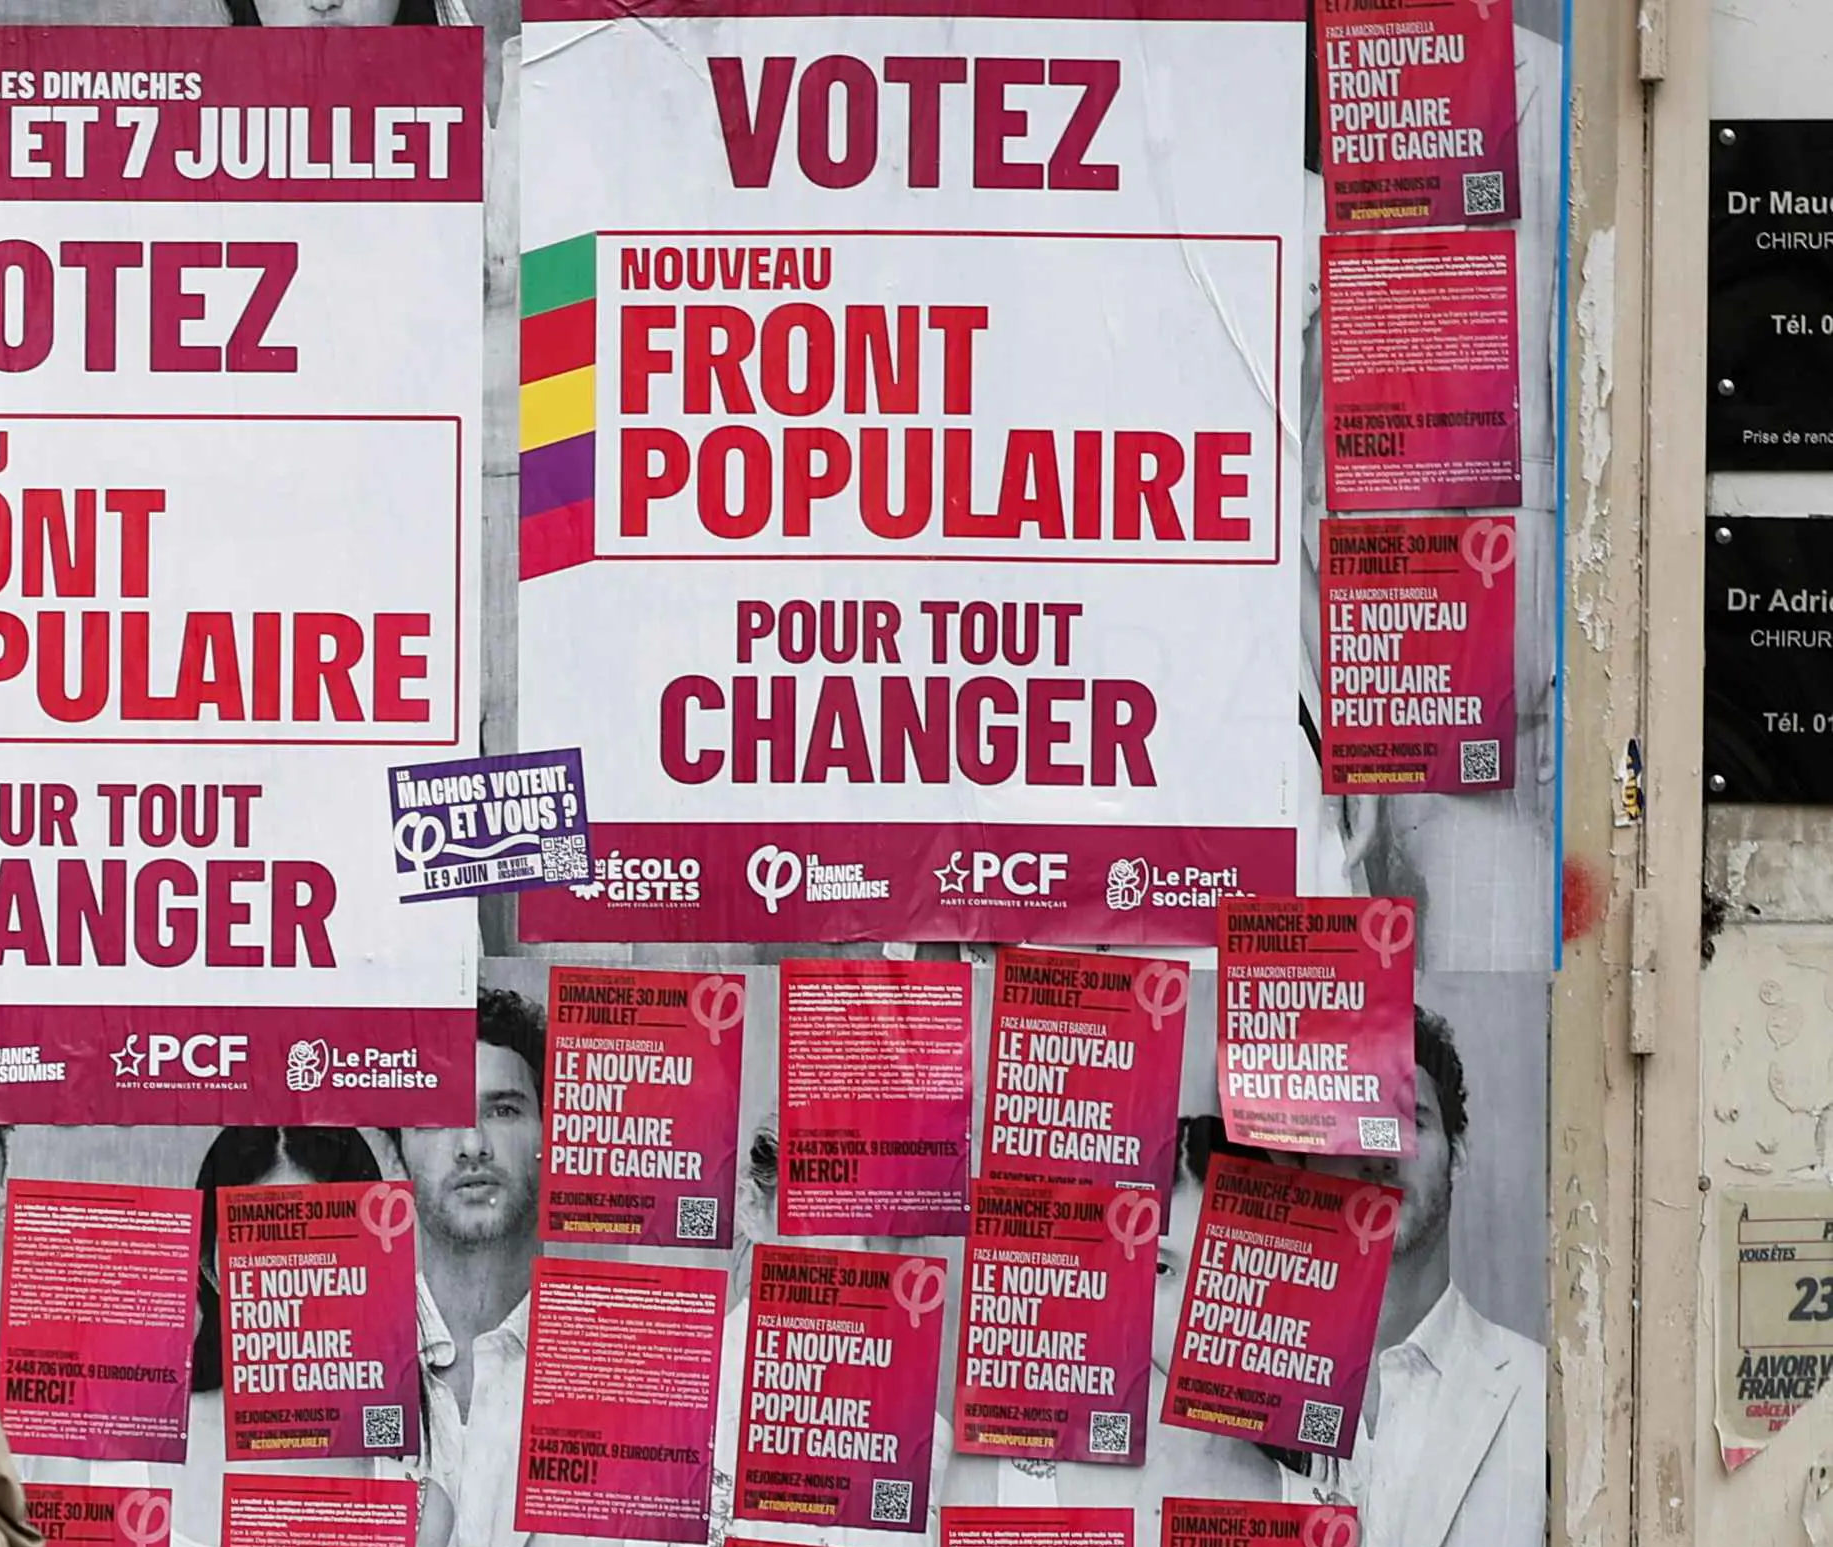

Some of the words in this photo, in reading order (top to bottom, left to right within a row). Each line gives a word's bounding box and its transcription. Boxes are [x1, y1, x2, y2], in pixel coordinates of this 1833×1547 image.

[43, 72, 202, 101] DIMANCHES
[706, 54, 1121, 191] VOTEZ
[10, 106, 99, 180] ET
[116, 106, 160, 180] 7
[174, 106, 464, 180] JUILLET
[1728, 191, 1761, 215] Dr
[621, 246, 832, 291] NOUVEAU
[1771, 315, 1813, 334] Tél.
[620, 303, 989, 418] FRONT
[1743, 430, 1778, 444] Prise
[1783, 430, 1800, 444] de
[619, 426, 1251, 542] POPULAIRE
[1727, 588, 1761, 611] Dr
[1330, 604, 1354, 632] LE
[1361, 602, 1467, 631] NOUVEAU
[737, 601, 901, 665] POUR
[920, 601, 1083, 666] TOUT
[1330, 634, 1403, 662] FRONT
[1330, 665, 1451, 695] POPULAIRE
[1332, 698, 1387, 727] PEUT
[1391, 696, 1482, 726] GAGNER
[1763, 712, 1804, 732] Tél.
[660, 675, 1158, 788] CHANGER
[397, 774, 487, 809] MACHOS
[489, 766, 574, 799] VOTENT.
[97, 784, 263, 849] TOUT
[449, 804, 477, 839] ET
[483, 796, 557, 836] VOUS
[424, 871, 438, 890] LE
[442, 870, 450, 886] 9
[454, 864, 488, 885] JUIN
[608, 850, 700, 879] ÉCOLO
[972, 851, 1067, 895] PCF
[608, 879, 700, 902] GISTES
